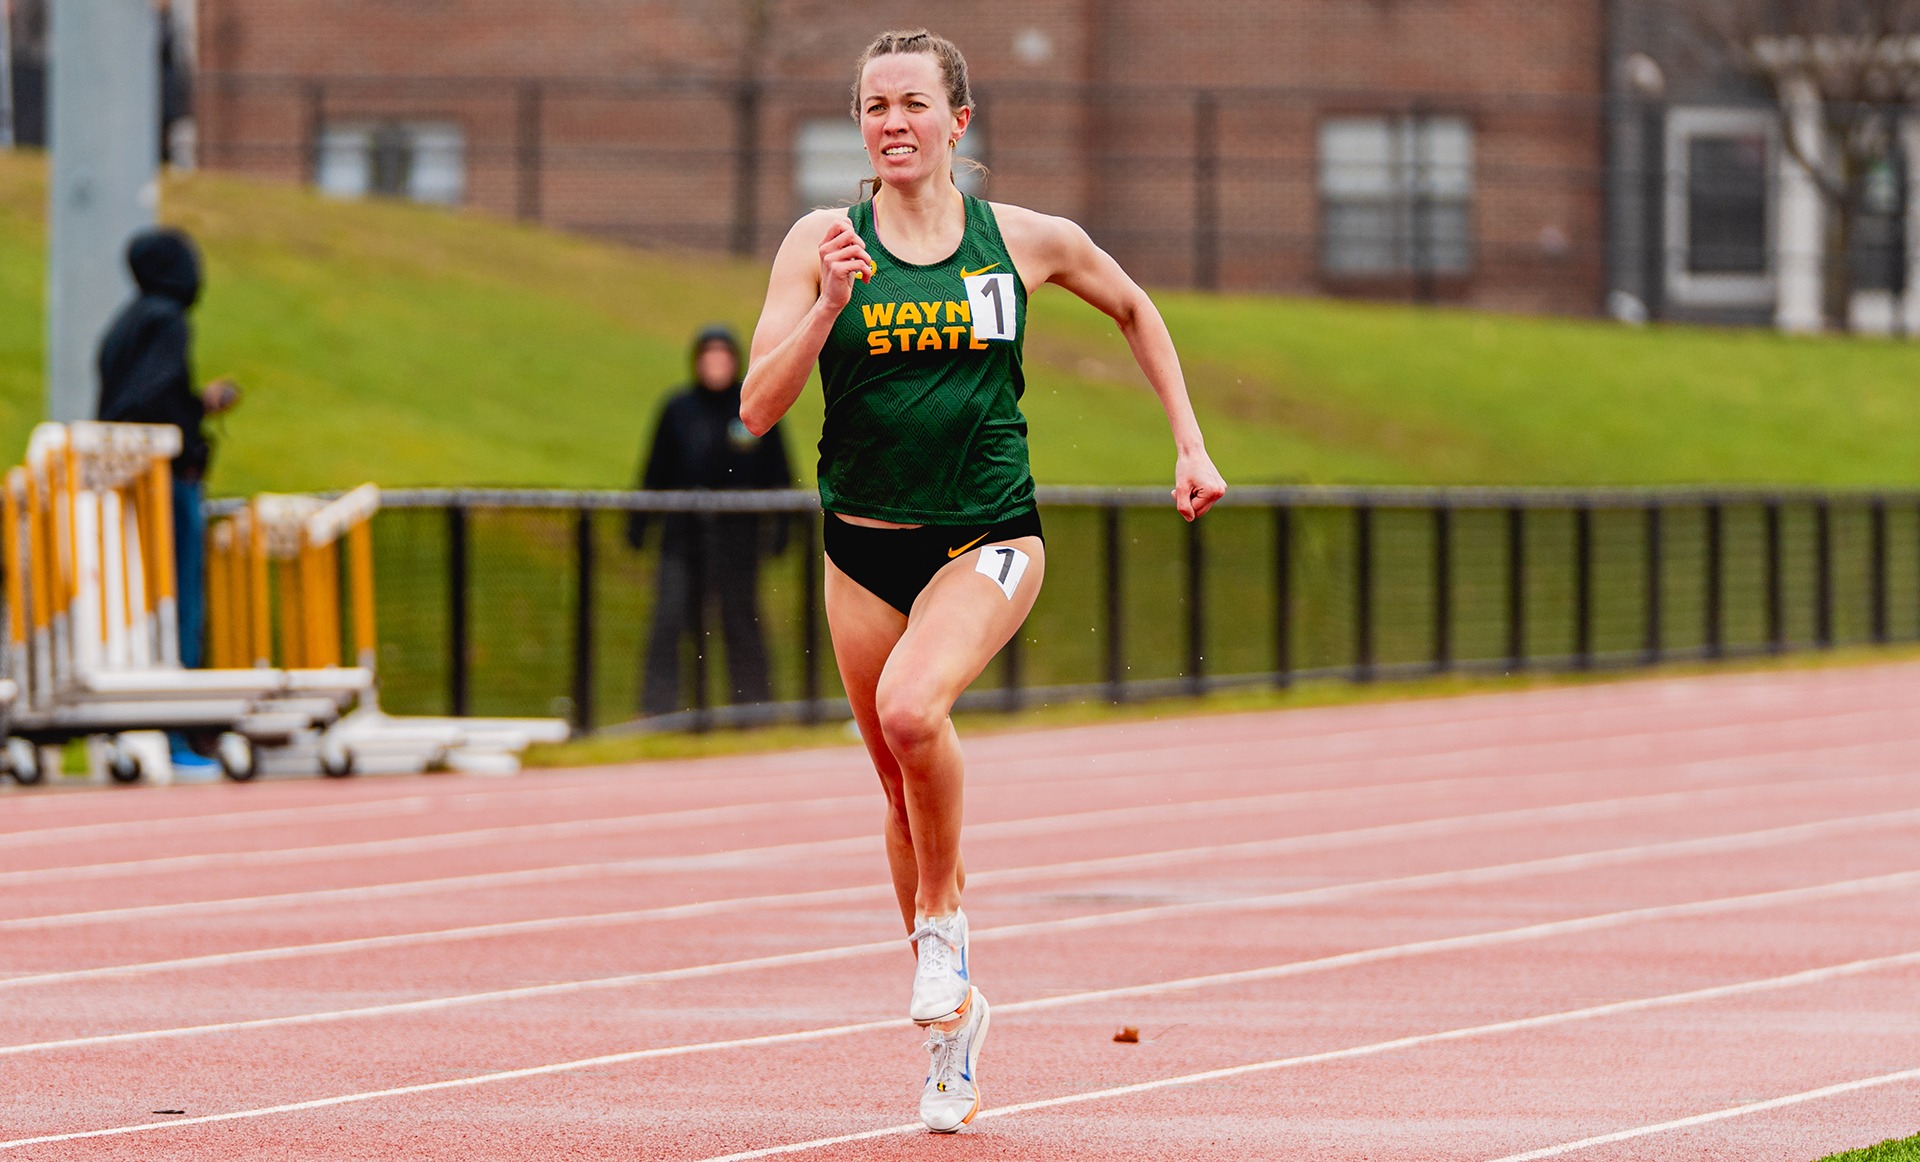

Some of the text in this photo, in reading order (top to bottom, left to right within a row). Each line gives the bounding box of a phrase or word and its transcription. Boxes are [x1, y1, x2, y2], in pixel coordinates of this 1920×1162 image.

[862, 300, 971, 328] WAYN
[981, 277, 1004, 335] 1
[995, 548, 1015, 585] 1
